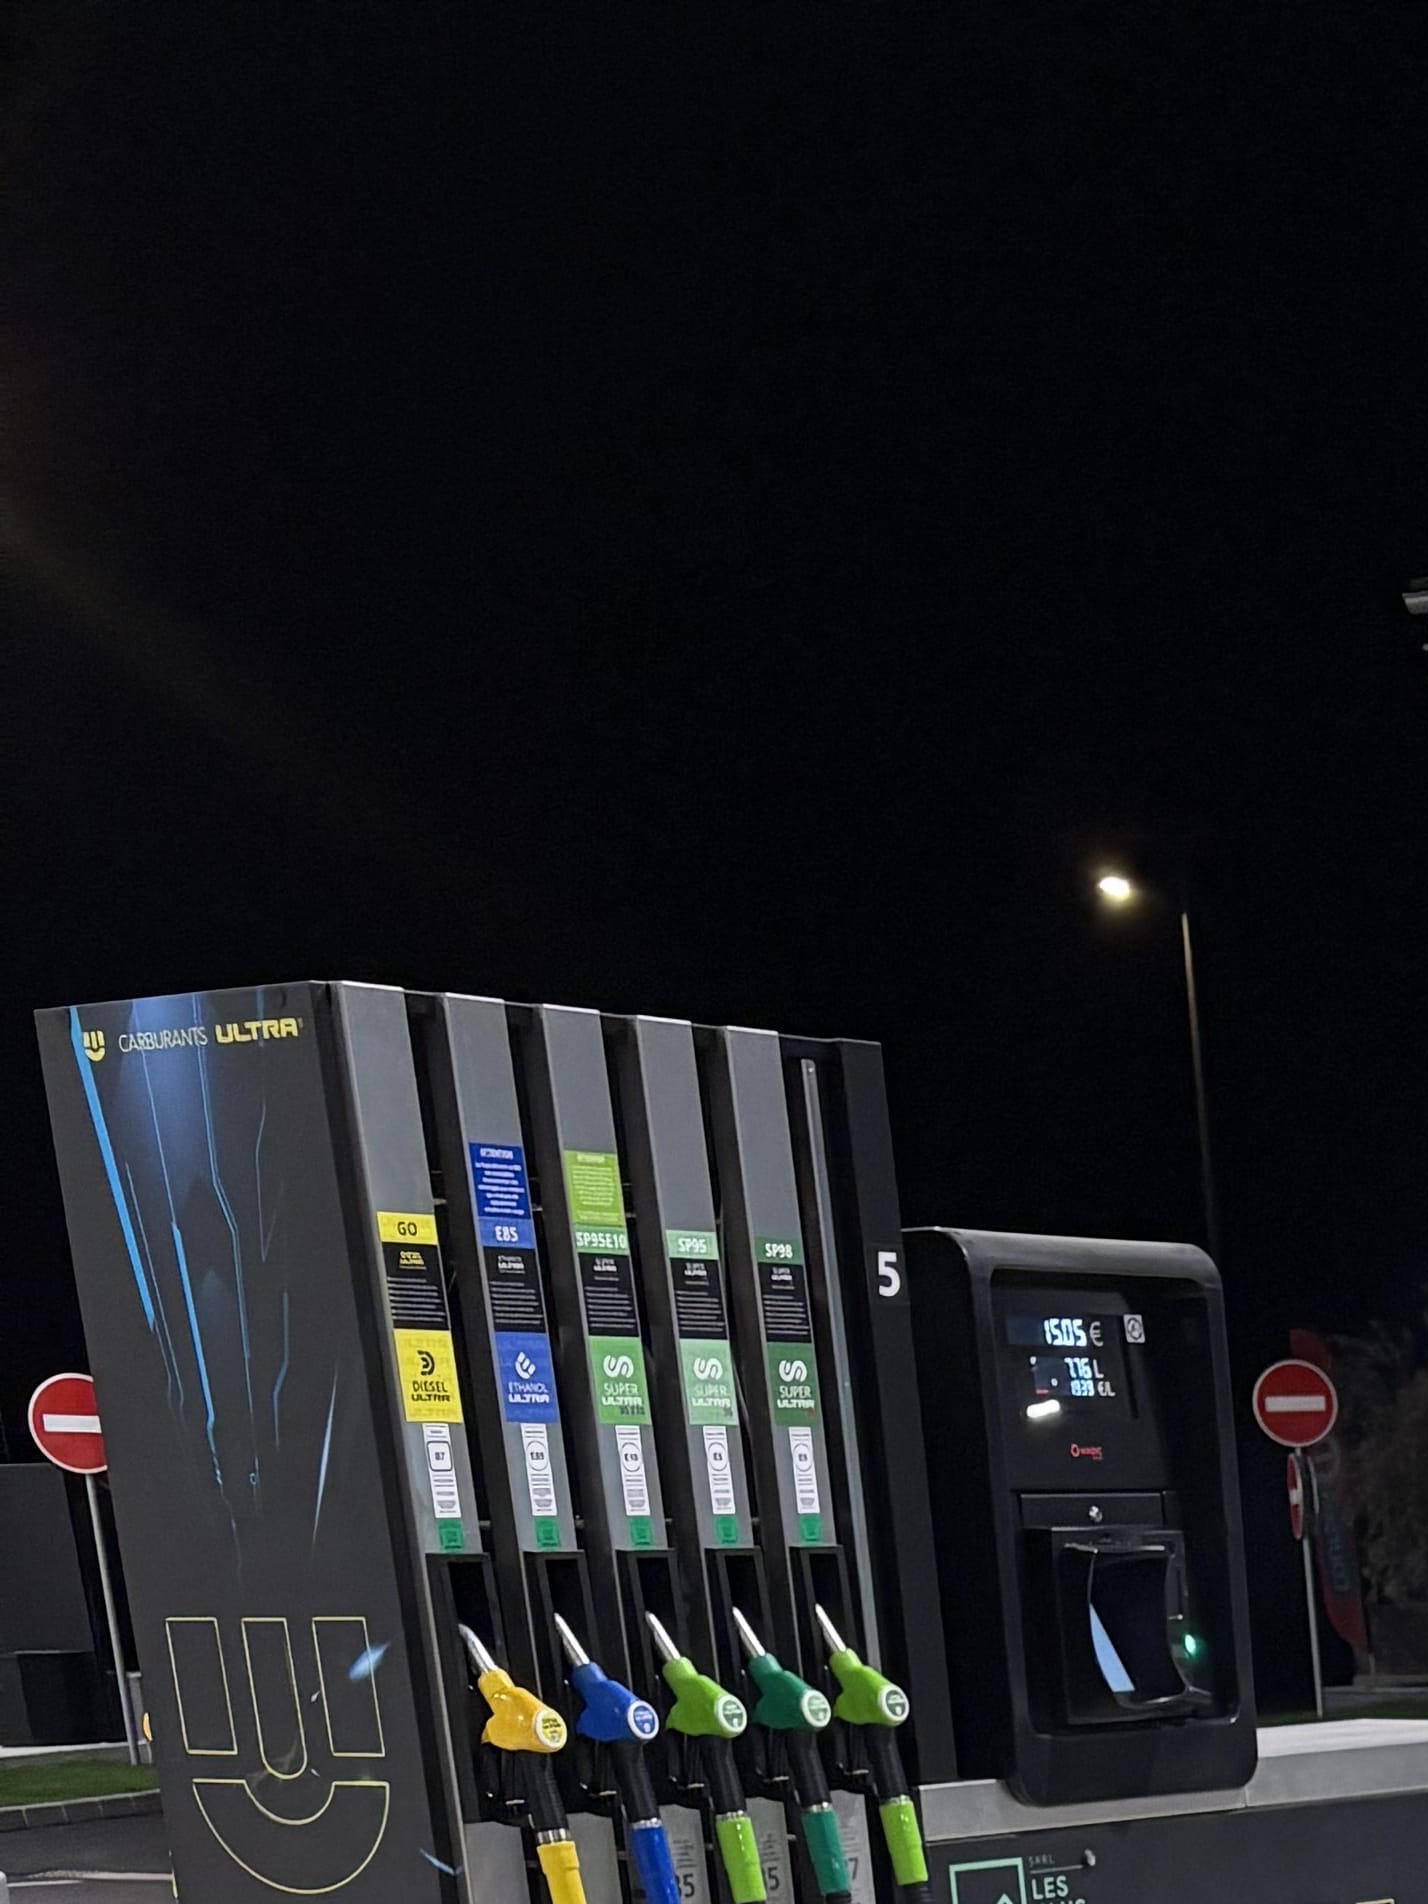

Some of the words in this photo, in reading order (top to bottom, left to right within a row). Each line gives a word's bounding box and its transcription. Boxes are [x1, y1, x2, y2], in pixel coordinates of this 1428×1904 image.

[118, 1027, 208, 1052] CARBURANTS
[215, 1017, 299, 1044] ULTRA
[397, 1221, 418, 1236] GO
[494, 1225, 519, 1242] E85
[575, 1231, 627, 1249] SP95E10
[677, 1237, 707, 1254] SP95
[765, 1243, 793, 1258] SP98
[878, 1251, 900, 1297] 5
[412, 1380, 448, 1393] DIESEL
[508, 1382, 549, 1393] ETHANOL
[604, 1383, 639, 1396] SUPER
[779, 1385, 811, 1398] SUPER
[1031, 1875, 1069, 1900] LES
